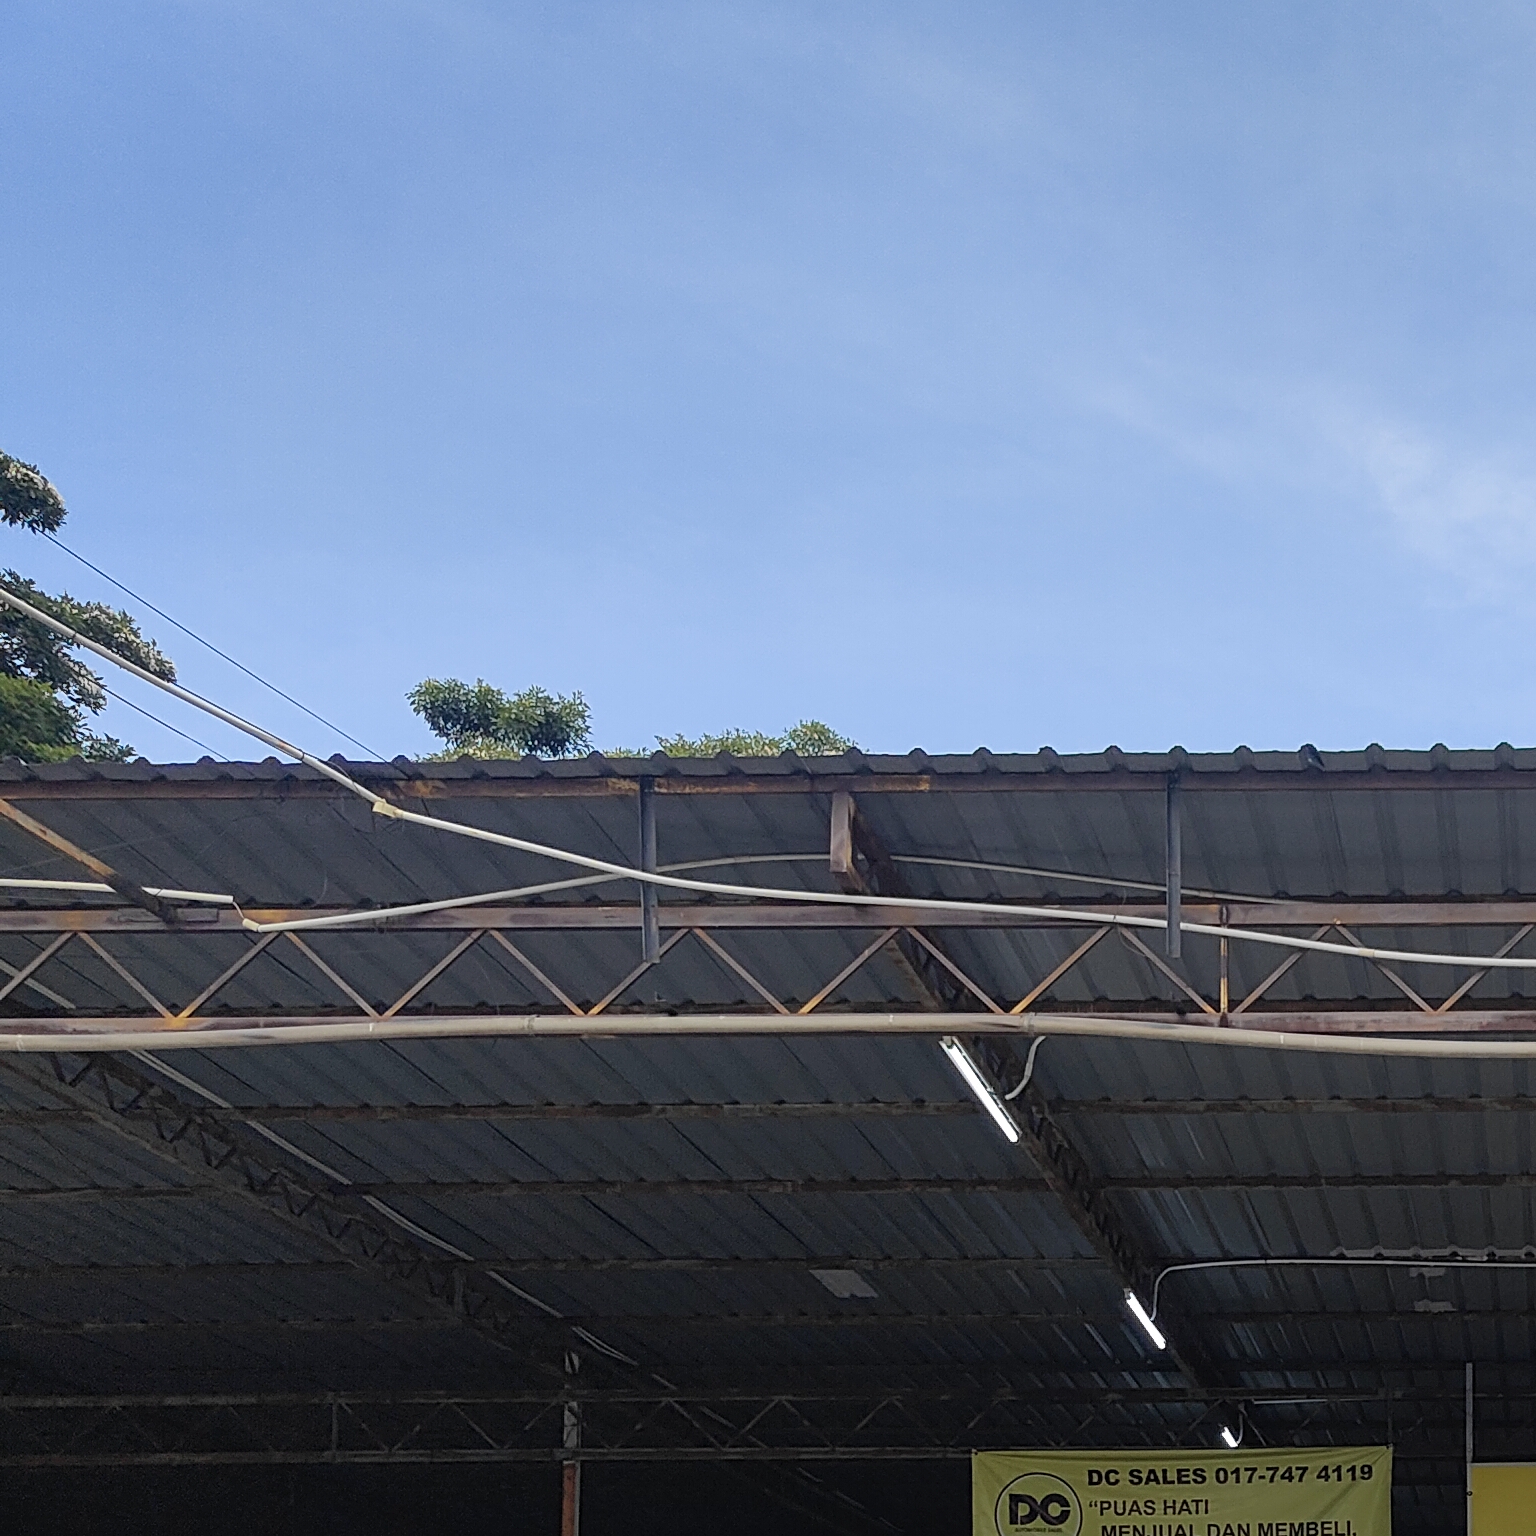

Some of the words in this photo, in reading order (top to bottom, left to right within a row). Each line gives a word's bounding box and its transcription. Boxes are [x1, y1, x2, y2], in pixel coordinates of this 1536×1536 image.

[1087, 1468, 1120, 1486] DC
[1128, 1467, 1207, 1486] SALES
[1215, 1466, 1309, 1485] 017-747
[1316, 1464, 1373, 1482] 4119
[1009, 1493, 1071, 1526] DC
[1163, 1498, 1209, 1515] HATI
